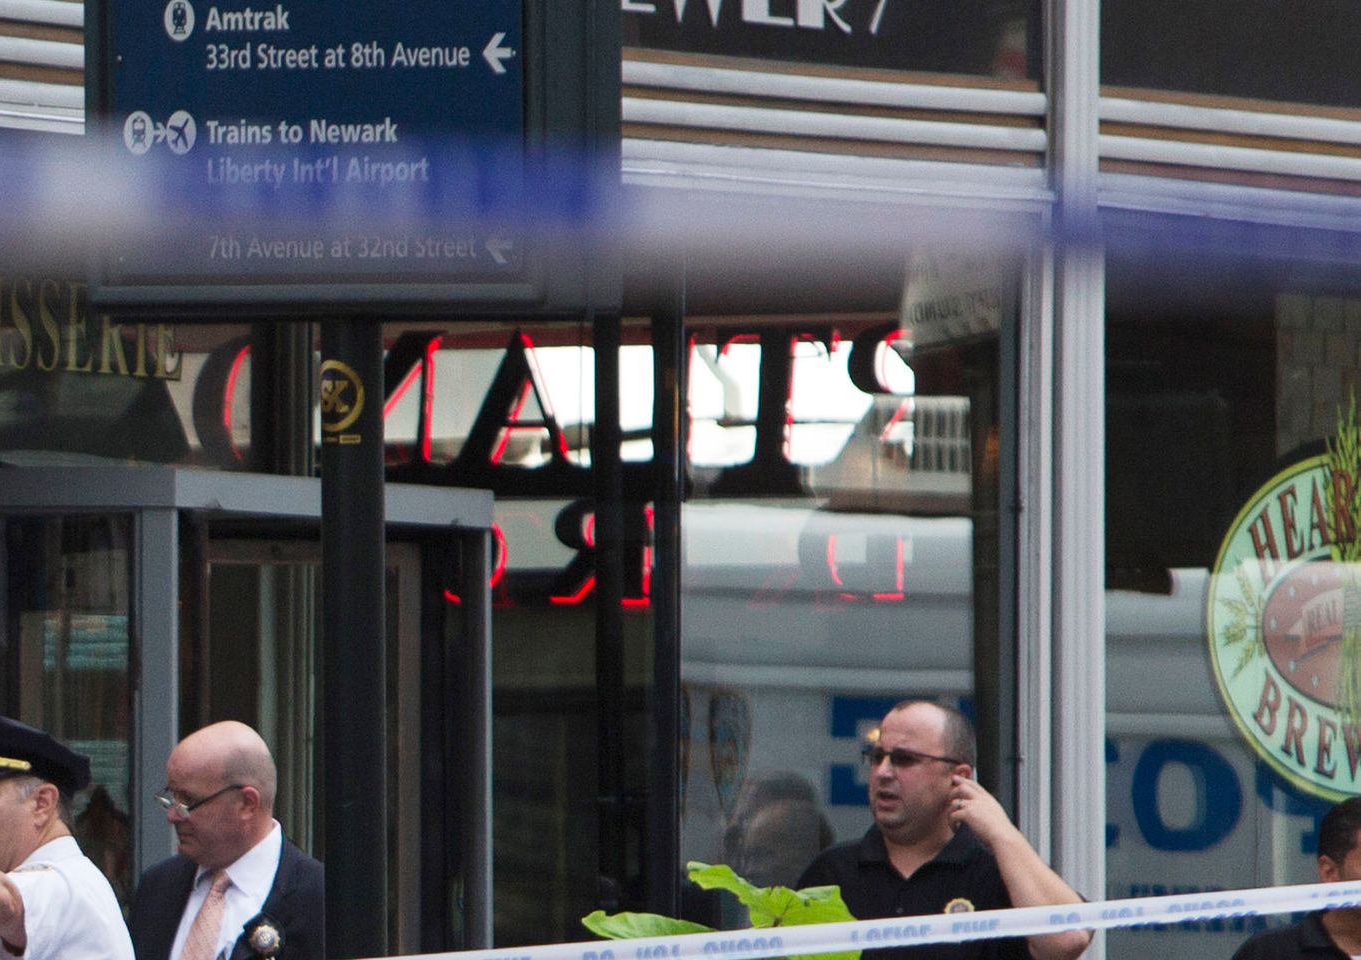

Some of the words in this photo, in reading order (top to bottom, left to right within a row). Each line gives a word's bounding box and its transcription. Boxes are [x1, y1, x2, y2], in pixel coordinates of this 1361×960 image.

[205, 4, 289, 31] Amtrak
[206, 42, 251, 70] 33rd
[257, 43, 318, 70] Street
[324, 45, 345, 68] at
[351, 41, 384, 68] 8th
[391, 41, 470, 67] Avenue
[206, 119, 272, 144] Trains
[278, 120, 303, 143] to
[309, 117, 398, 144] Newark
[207, 156, 287, 190] Liberty
[345, 155, 430, 188] Airport
[209, 235, 240, 258] 7th
[246, 236, 324, 259] Avenue
[330, 236, 352, 257] at
[357, 236, 408, 258] 32nd
[415, 236, 476, 258] Street
[1248, 469, 1361, 588] HEAR
